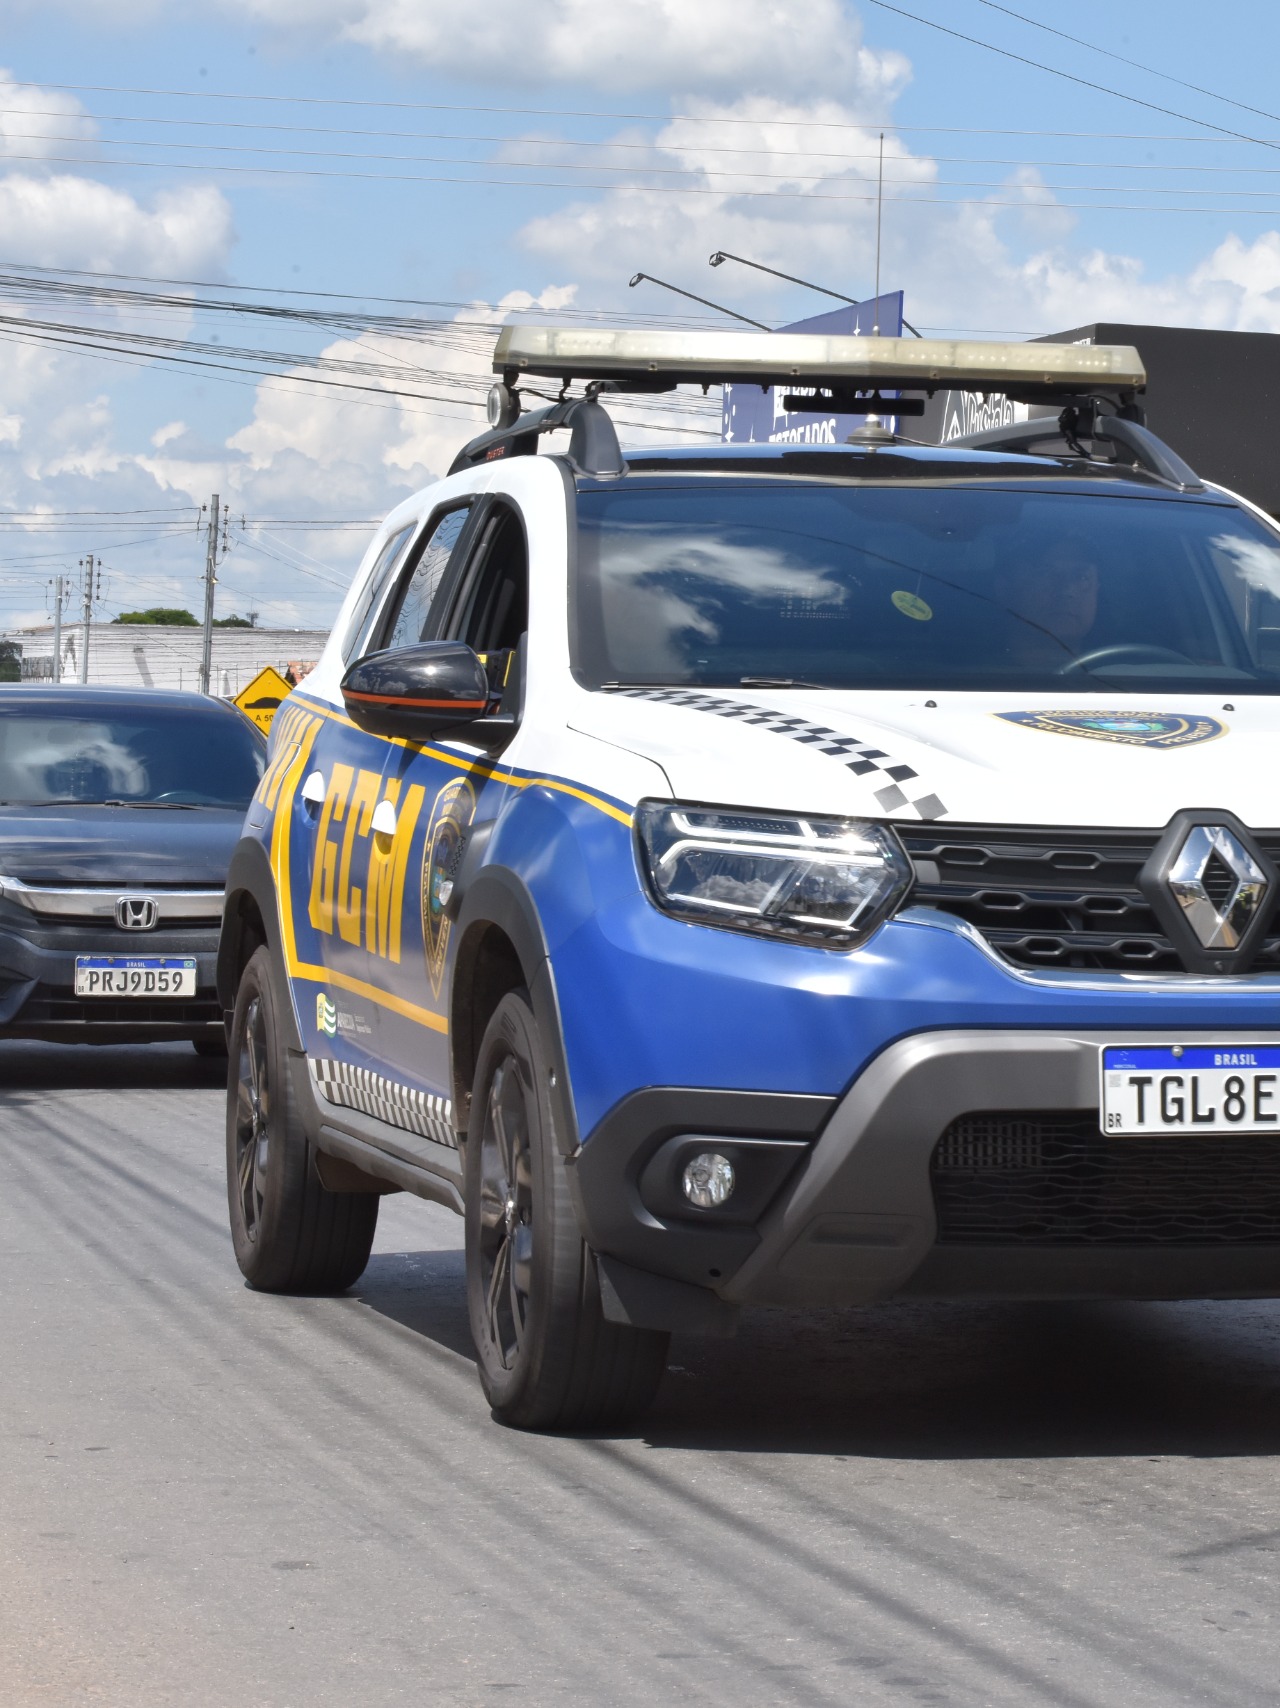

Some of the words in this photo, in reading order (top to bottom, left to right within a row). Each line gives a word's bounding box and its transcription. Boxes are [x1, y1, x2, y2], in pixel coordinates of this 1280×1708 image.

[255, 714, 262, 722] A
[308, 762, 426, 964] GCM
[88, 970, 183, 992] PRJ9D59
[1214, 1053, 1258, 1066] BRASIL
[1107, 1113, 1123, 1128] BR
